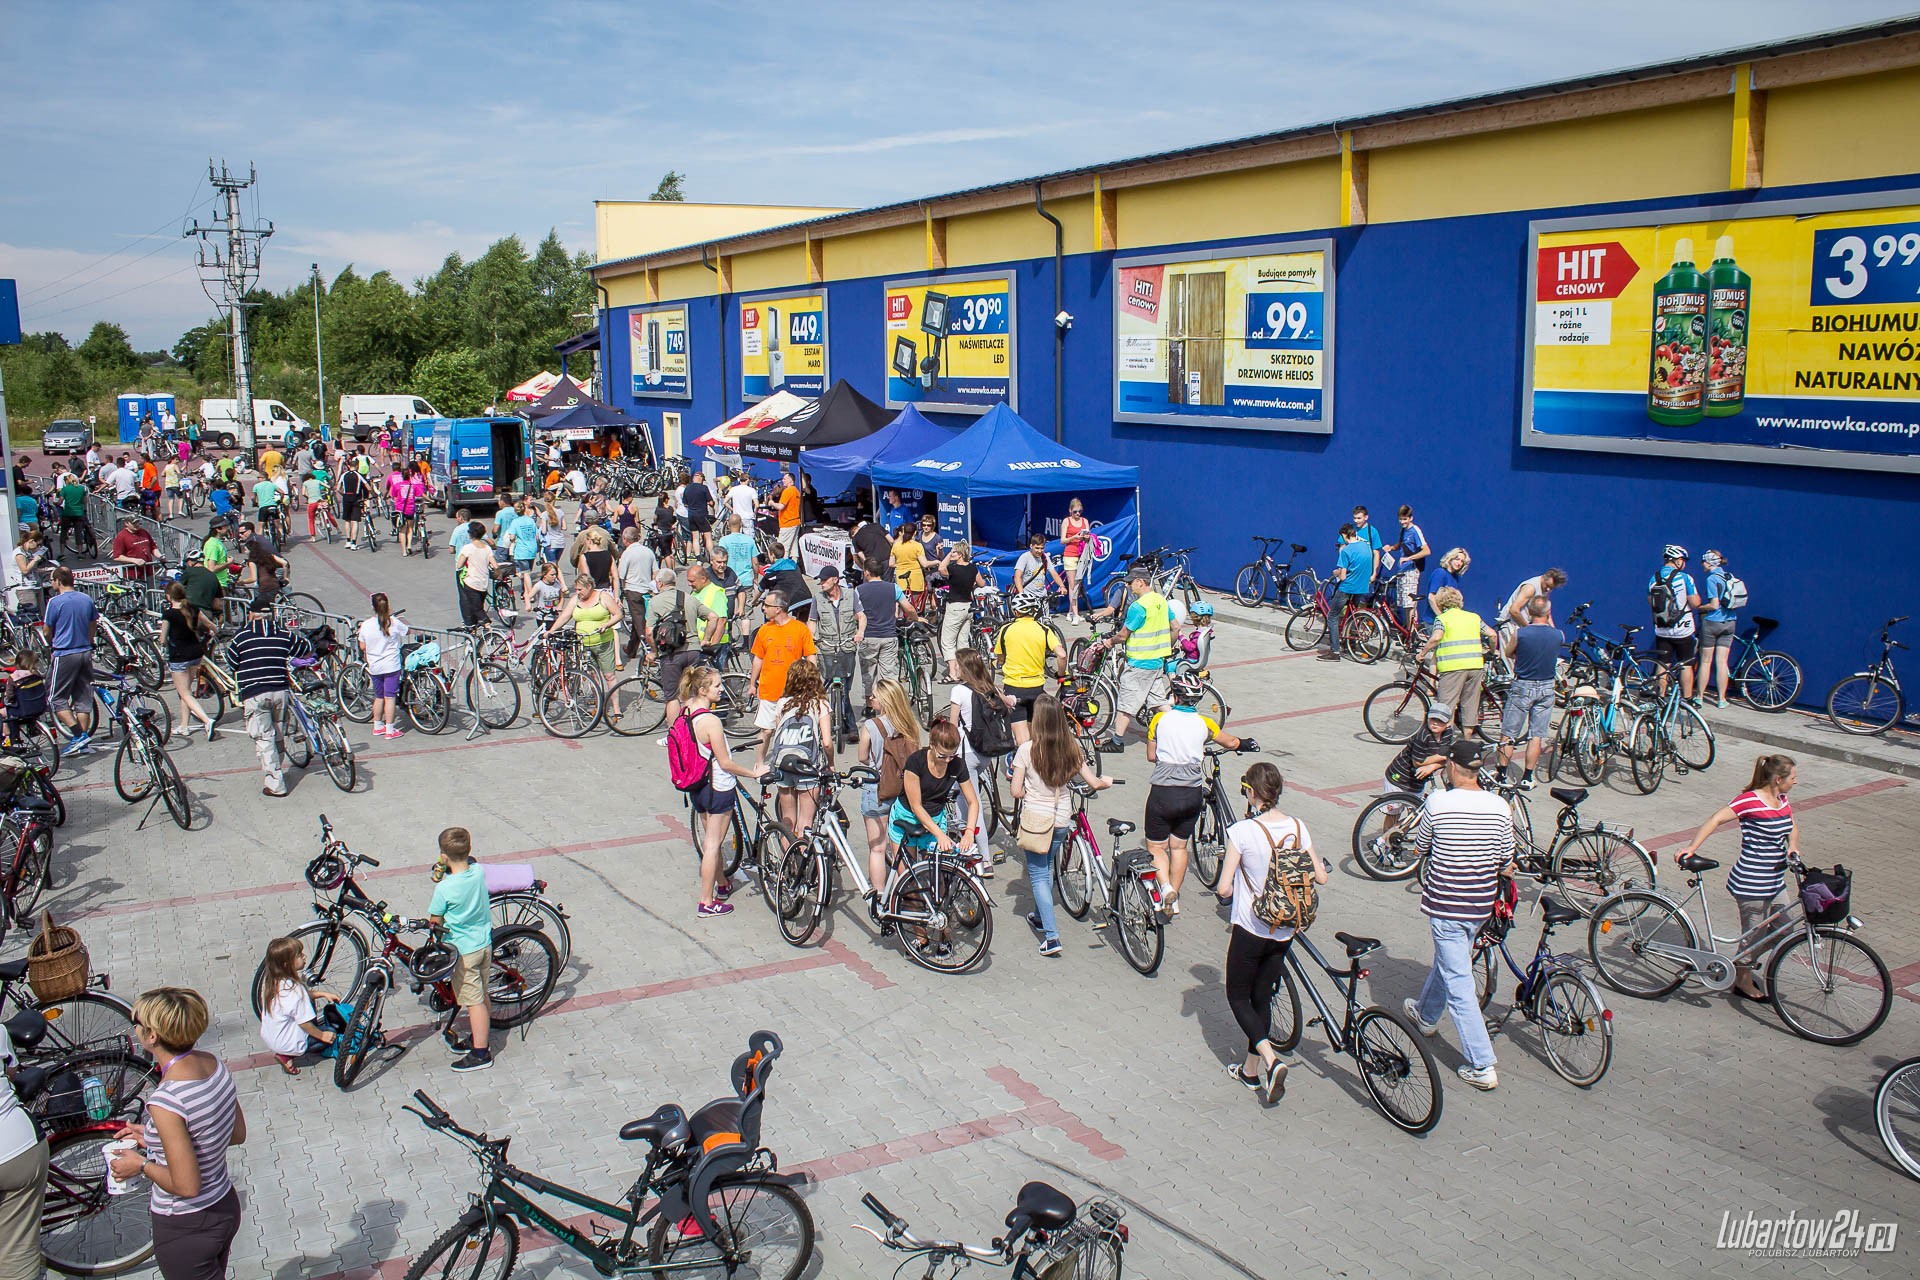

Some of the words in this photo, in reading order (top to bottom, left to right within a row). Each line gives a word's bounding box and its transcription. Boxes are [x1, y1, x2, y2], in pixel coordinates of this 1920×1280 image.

[1557, 248, 1607, 281] HIT
[1257, 269, 1287, 280] Budujące
[1287, 267, 1317, 279] pomysły
[1134, 279, 1154, 298] HIT!
[1556, 282, 1606, 296] CENOWY
[1658, 294, 1705, 308] BIOHUMUS
[1713, 291, 1746, 301] HUMUS
[892, 297, 906, 312] HIT
[1127, 296, 1157, 314] cenowy
[1560, 307, 1573, 319] poj
[1575, 307, 1579, 316] 1
[951, 318, 961, 331] od
[1559, 320, 1582, 330] różne
[1811, 312, 1920, 333] BIOHUMU
[1251, 327, 1264, 339] od
[1559, 332, 1589, 344] rodzaje
[959, 337, 1004, 350] NAŚWIETLACZE
[993, 354, 1005, 364] LED
[1270, 354, 1315, 366] SKRZYDŁO
[1237, 368, 1283, 380] DRZWIOWE
[1285, 370, 1314, 381] HELIOS
[1232, 397, 1315, 412] www.mrowka.com.pl
[1756, 415, 1920, 438] www.mrowka.com.p
[1007, 461, 1062, 471] Allianz
[938, 502, 958, 513] Allianz
[1044, 517, 1062, 536] Alli
[780, 724, 814, 746] NIKE
